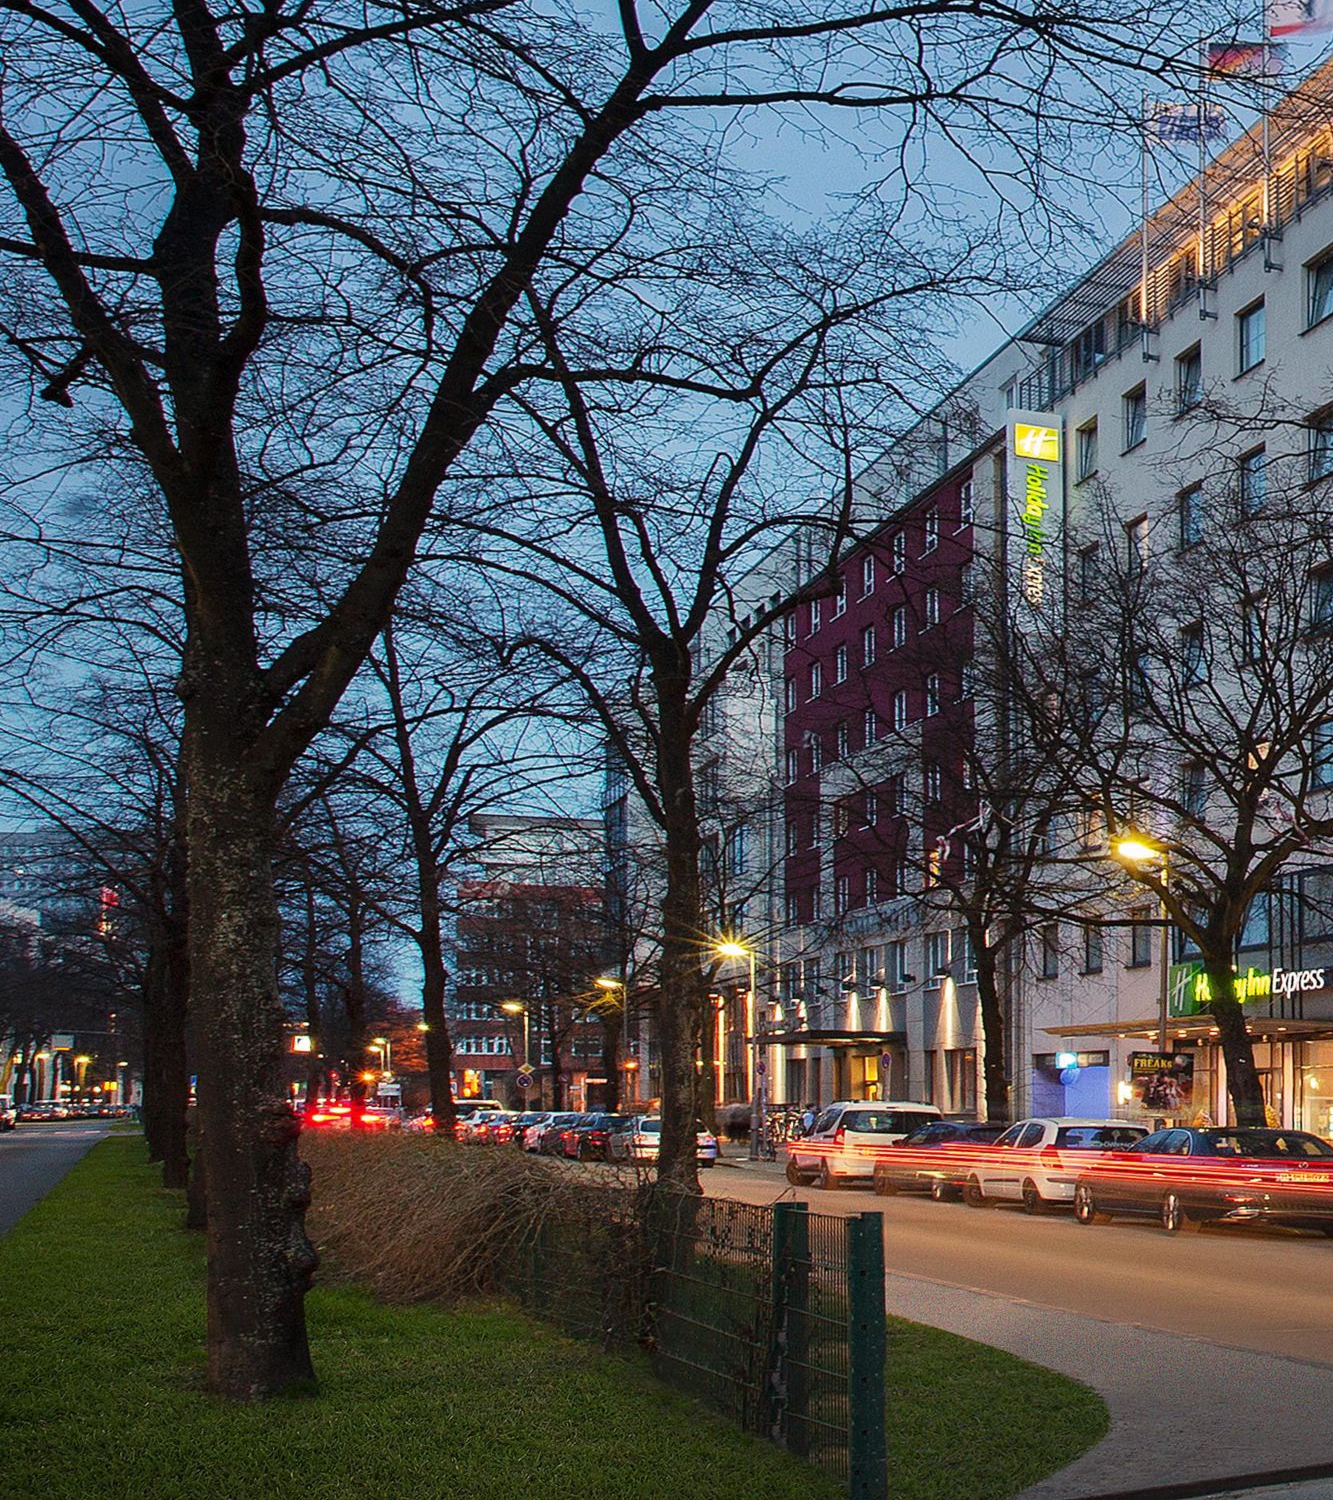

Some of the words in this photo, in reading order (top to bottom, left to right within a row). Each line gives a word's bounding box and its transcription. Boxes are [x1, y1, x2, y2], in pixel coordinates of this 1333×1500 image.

[1022, 463, 1049, 530] Holiday
[1247, 967, 1271, 997] Inn
[1272, 967, 1325, 1000] Express
